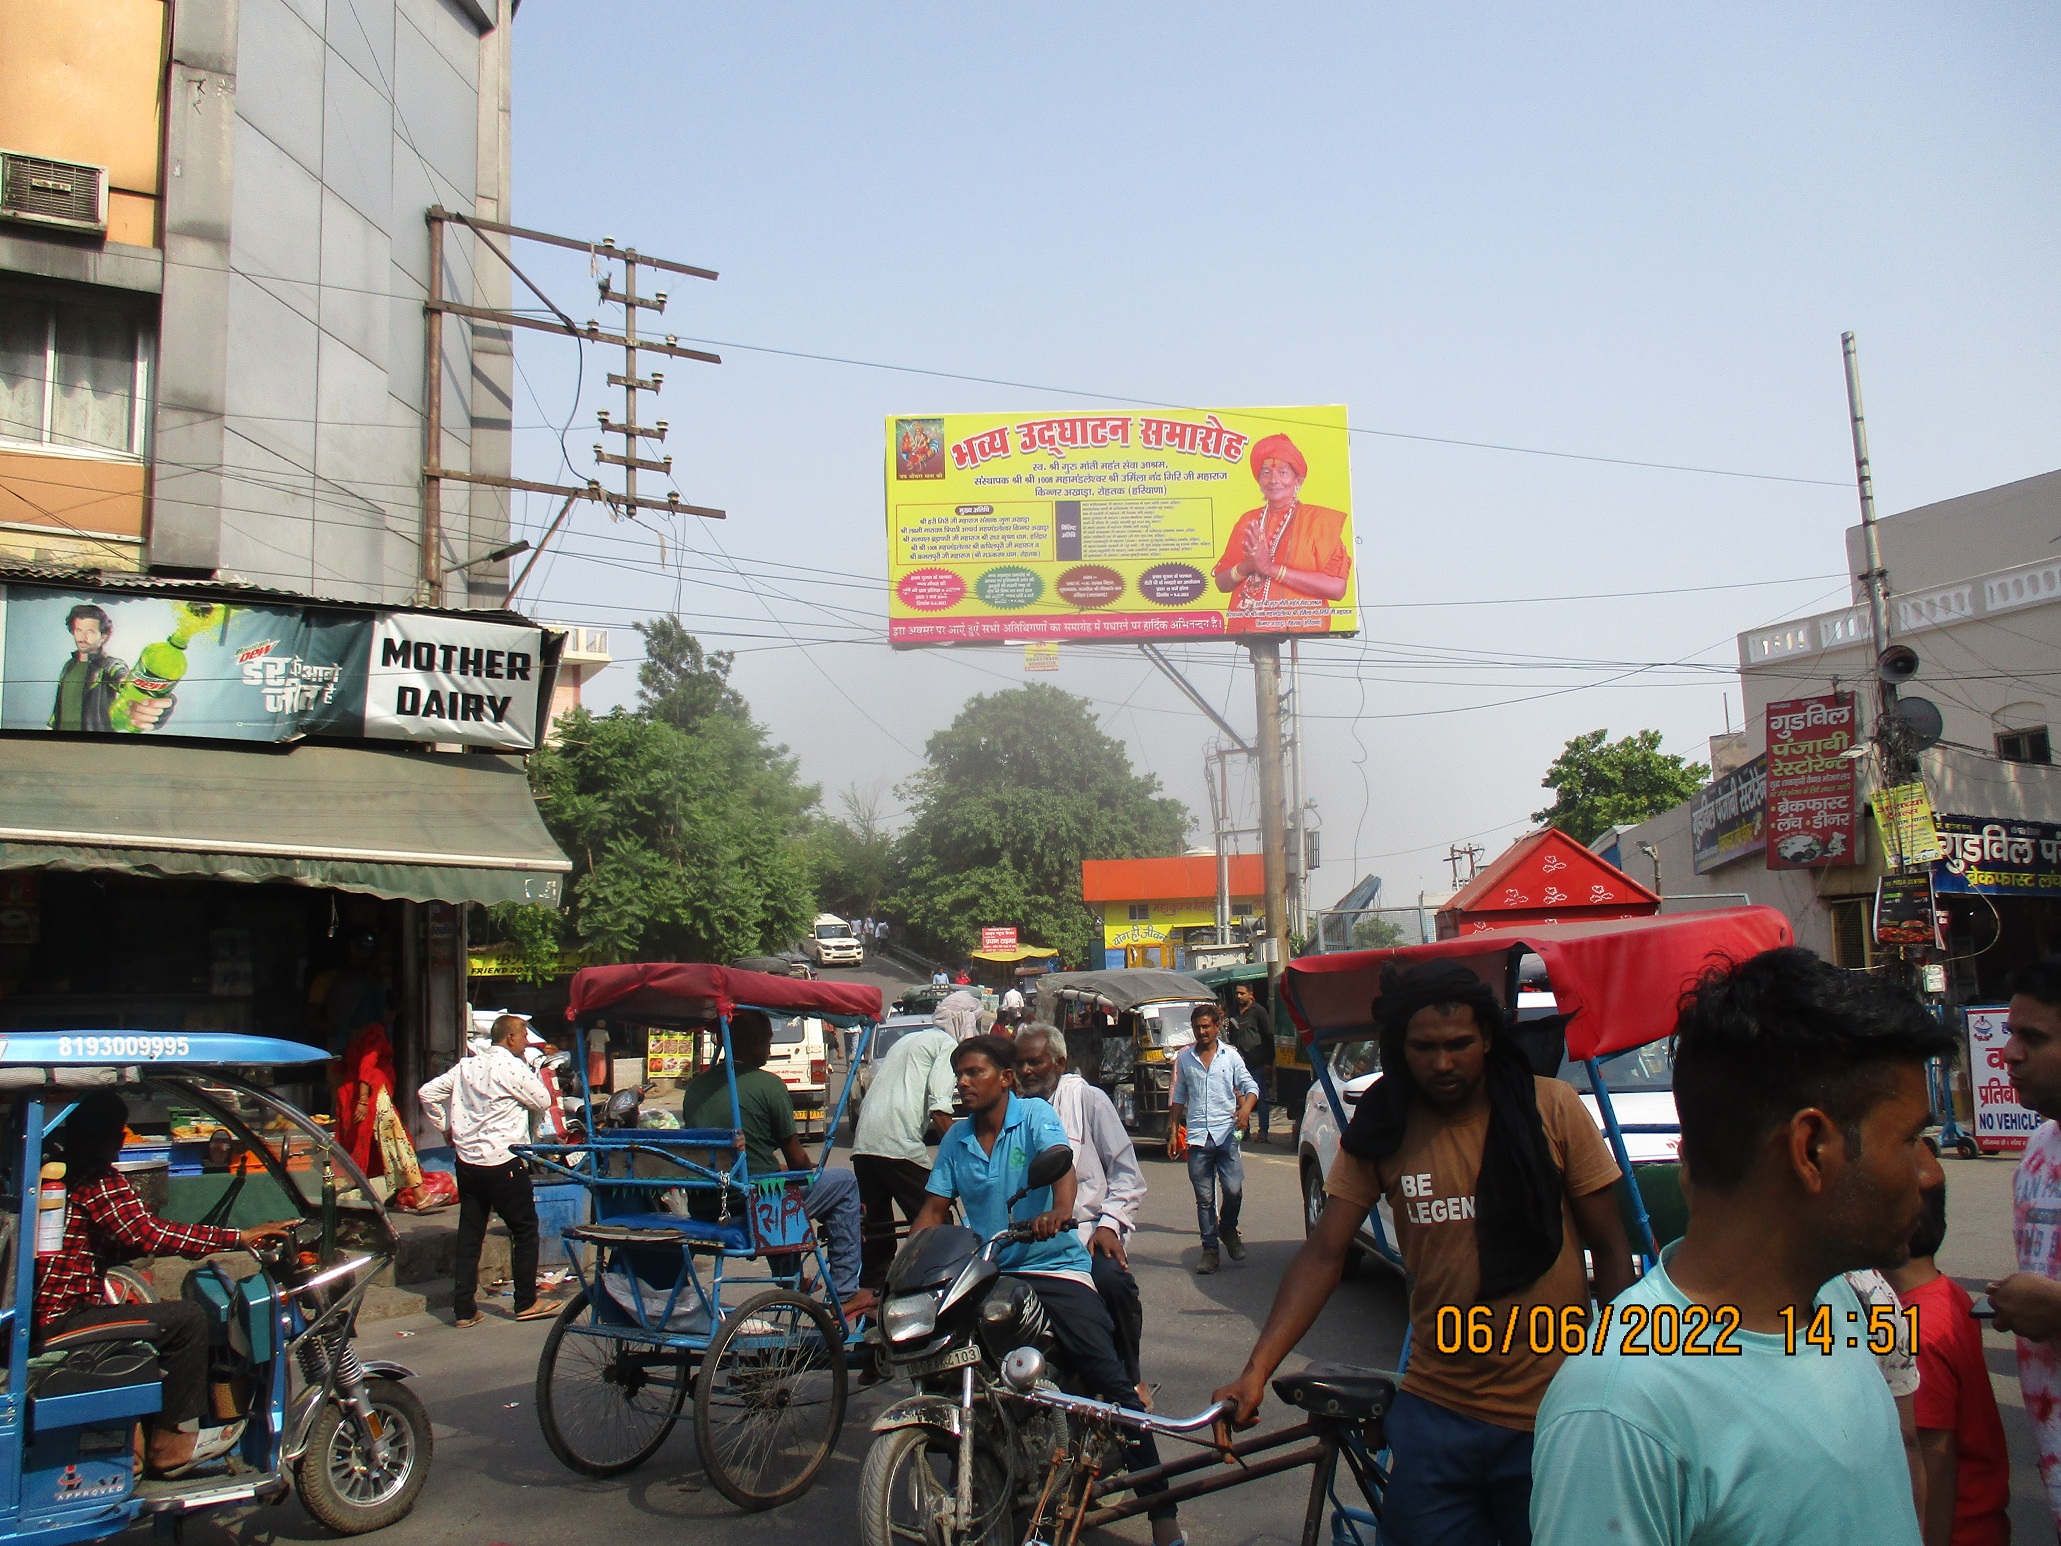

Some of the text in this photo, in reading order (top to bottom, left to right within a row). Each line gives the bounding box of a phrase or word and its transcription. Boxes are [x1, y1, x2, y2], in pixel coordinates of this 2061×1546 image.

[951, 426, 1011, 470] भव्य
[1139, 415, 1248, 462] समारोह
[974, 476, 1009, 486] संस्थापक
[1012, 475, 1022, 485] श्री
[1025, 474, 1035, 484] श्री
[1055, 474, 1106, 485] महामंडलेश्वर
[1108, 473, 1118, 483] श्री
[1149, 472, 1162, 482] नंद
[1164, 470, 1181, 482] गिरि
[1184, 470, 1194, 481] जी
[1196, 471, 1227, 481] महाराज
[1050, 462, 1060, 472] श्री
[1063, 462, 1077, 475] गुरु
[1080, 460, 1098, 471] मोती
[1100, 460, 1120, 471] महंत
[1122, 460, 1138, 470] सेवा
[1035, 487, 1061, 497] किन्नर
[1097, 486, 1125, 496] रोहतक
[1128, 484, 1167, 497] (हरियाणा)
[893, 626, 906, 638] इस
[909, 625, 935, 635] अवसर
[935, 625, 946, 634] पर
[982, 622, 1000, 634] सभी
[1003, 620, 1048, 634] अतिथिगणों
[1049, 622, 1061, 632] का
[1063, 620, 1092, 633] समारोह
[1093, 618, 1101, 632] में
[1103, 618, 1128, 631] पधारने
[1131, 621, 1141, 630] पर
[1143, 617, 1167, 631] हार्दिक
[1170, 616, 1209, 630] अभिनन्दन
[1211, 616, 1222, 630] है!
[242, 655, 343, 687] डर के आगे
[381, 637, 532, 682] MOTHER
[261, 677, 337, 715] जीत है
[396, 685, 512, 723] DAIRY
[1770, 704, 1852, 740] गुडविल
[1772, 730, 1850, 757] पंजाबी
[1771, 754, 1849, 777] रेस्टोरेन्ट
[1777, 795, 1850, 817] ब्रेकफास्ट
[1693, 794, 1716, 851] गुडविल
[1777, 810, 1851, 832] लंच डीनर
[1936, 824, 2036, 874] गुडविल
[1965, 865, 2036, 888] ब्रेकफास्ट
[1112, 924, 1168, 946] योग ही जीवन
[470, 966, 512, 975] FRIEND
[57, 1035, 190, 1057] 8193009995
[1979, 1113, 1993, 1129] NO
[1401, 1173, 1433, 1198] BE
[1406, 1196, 1476, 1224] LEGEN
